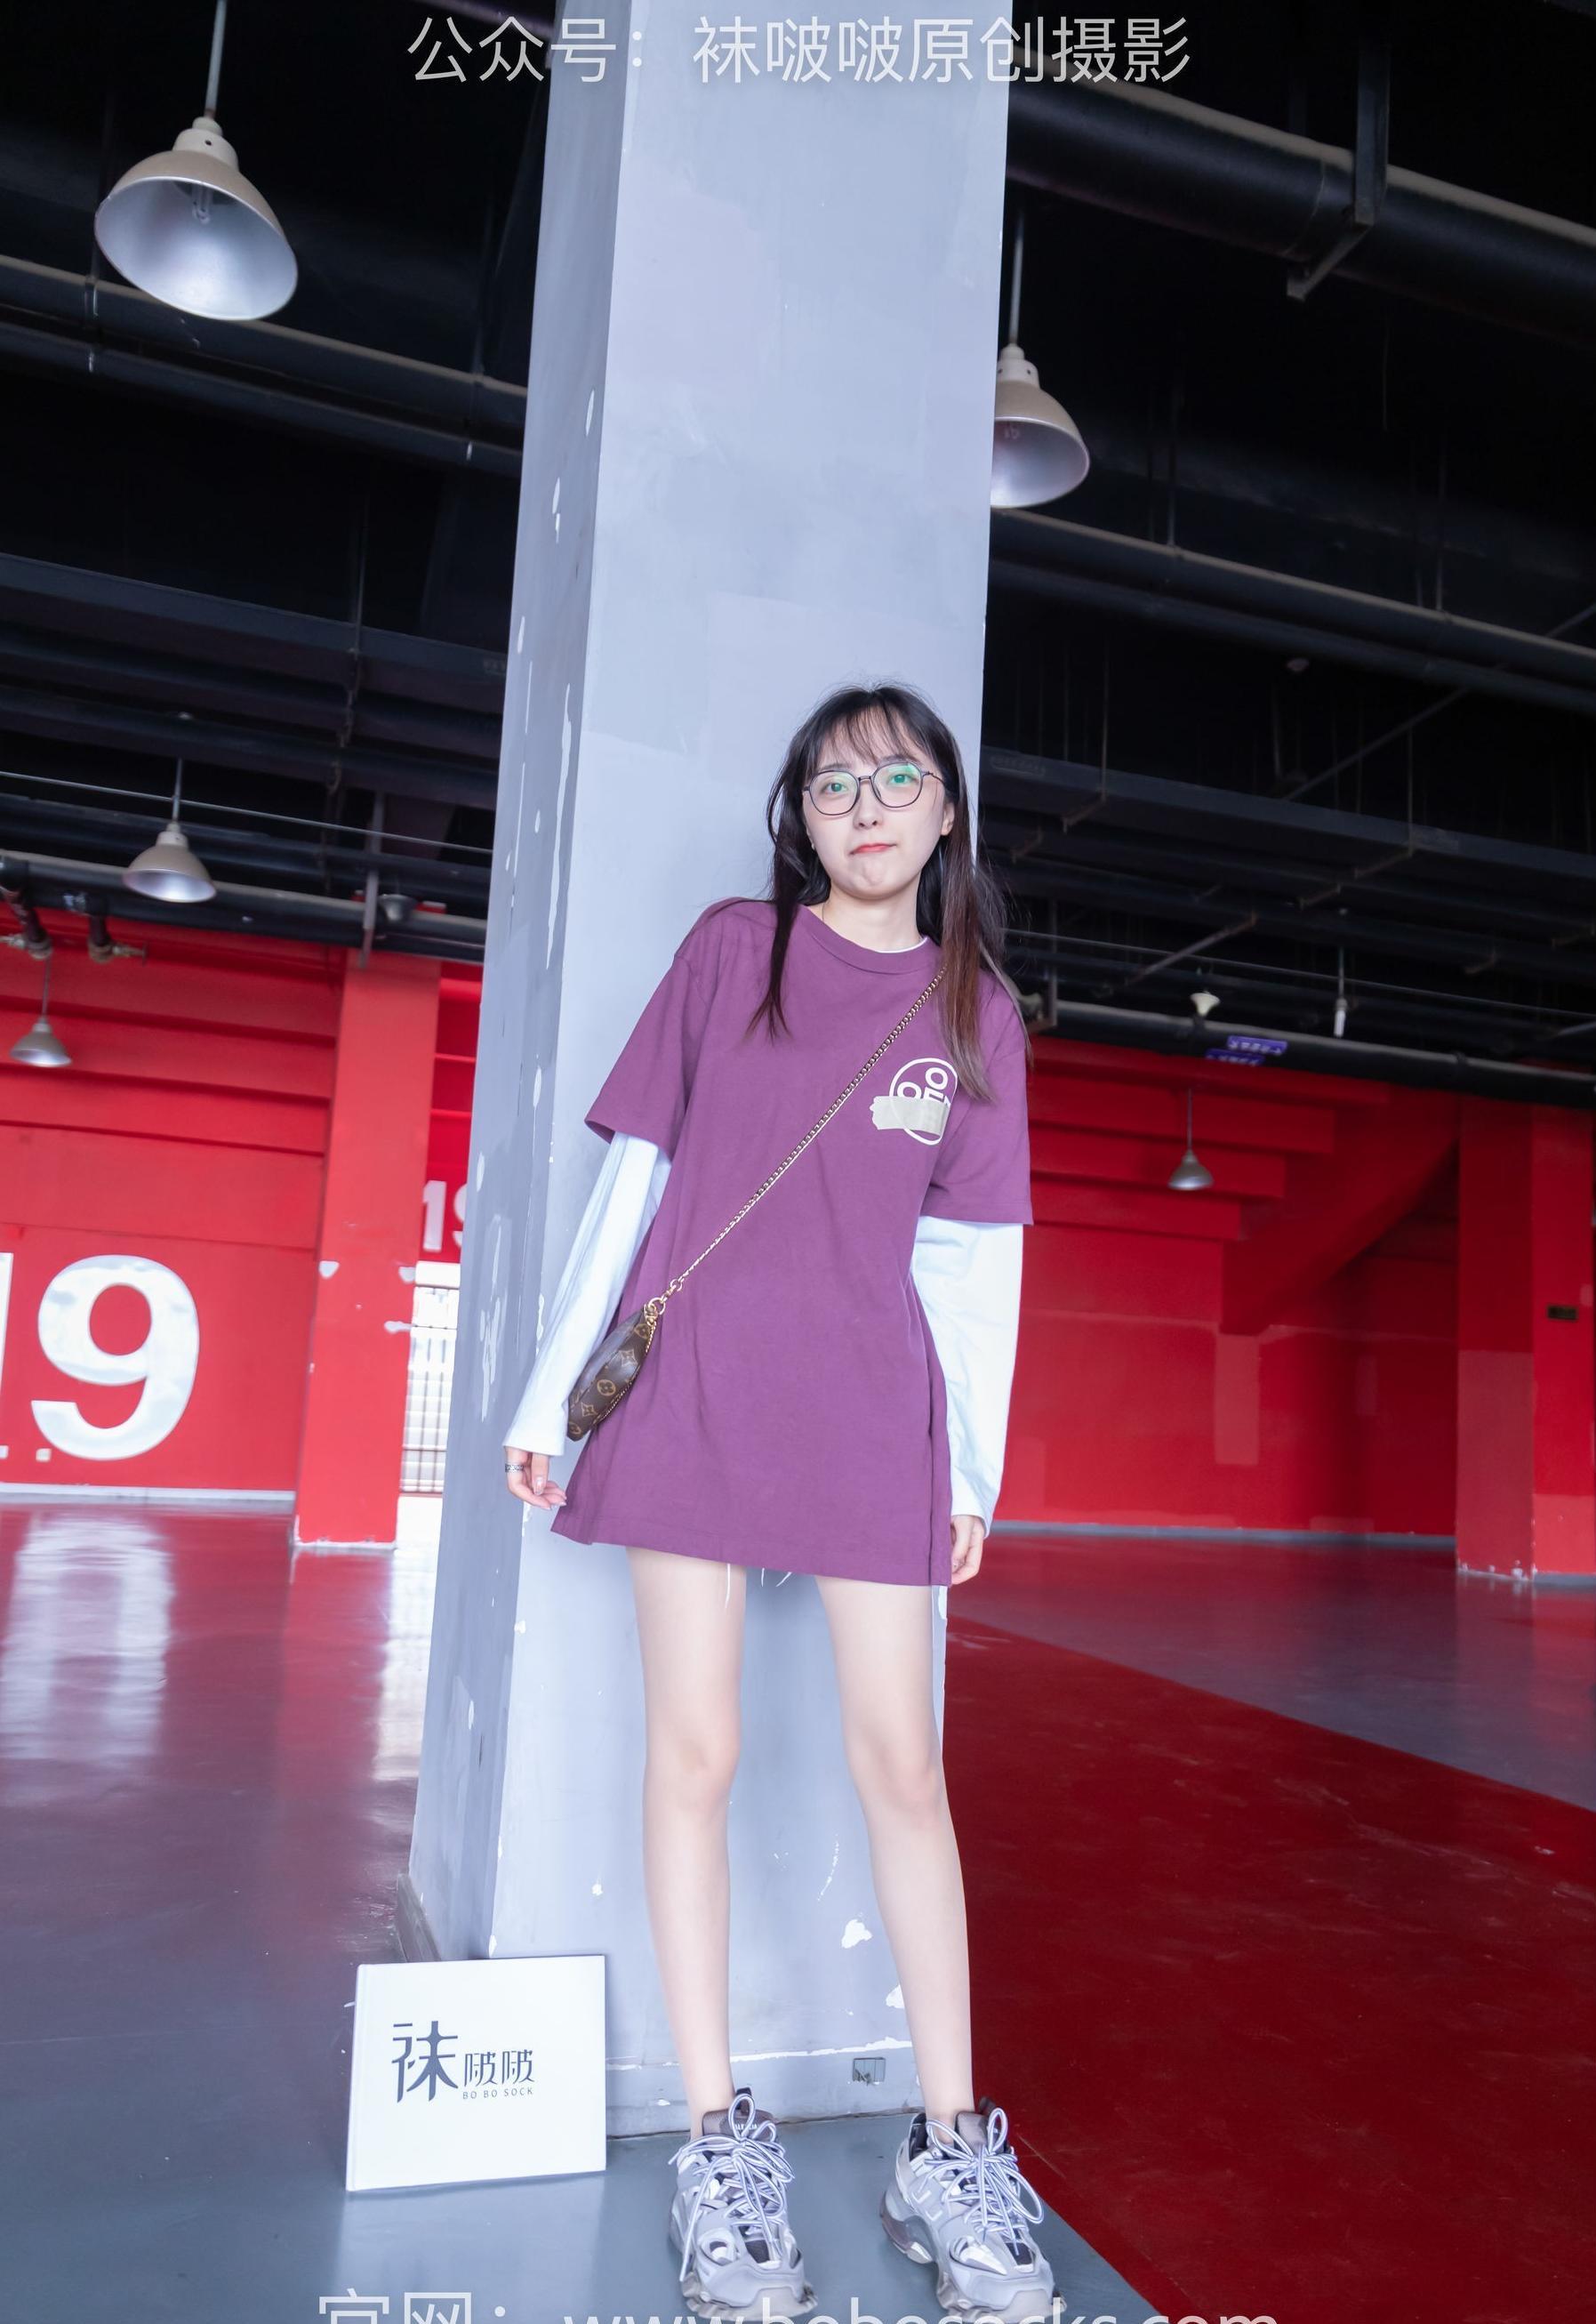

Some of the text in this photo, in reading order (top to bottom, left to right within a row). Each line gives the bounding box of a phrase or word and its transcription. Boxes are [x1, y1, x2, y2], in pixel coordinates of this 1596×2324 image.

[0, 1252, 200, 1461] 9
[462, 2087, 533, 2100] BO BO SOCK
